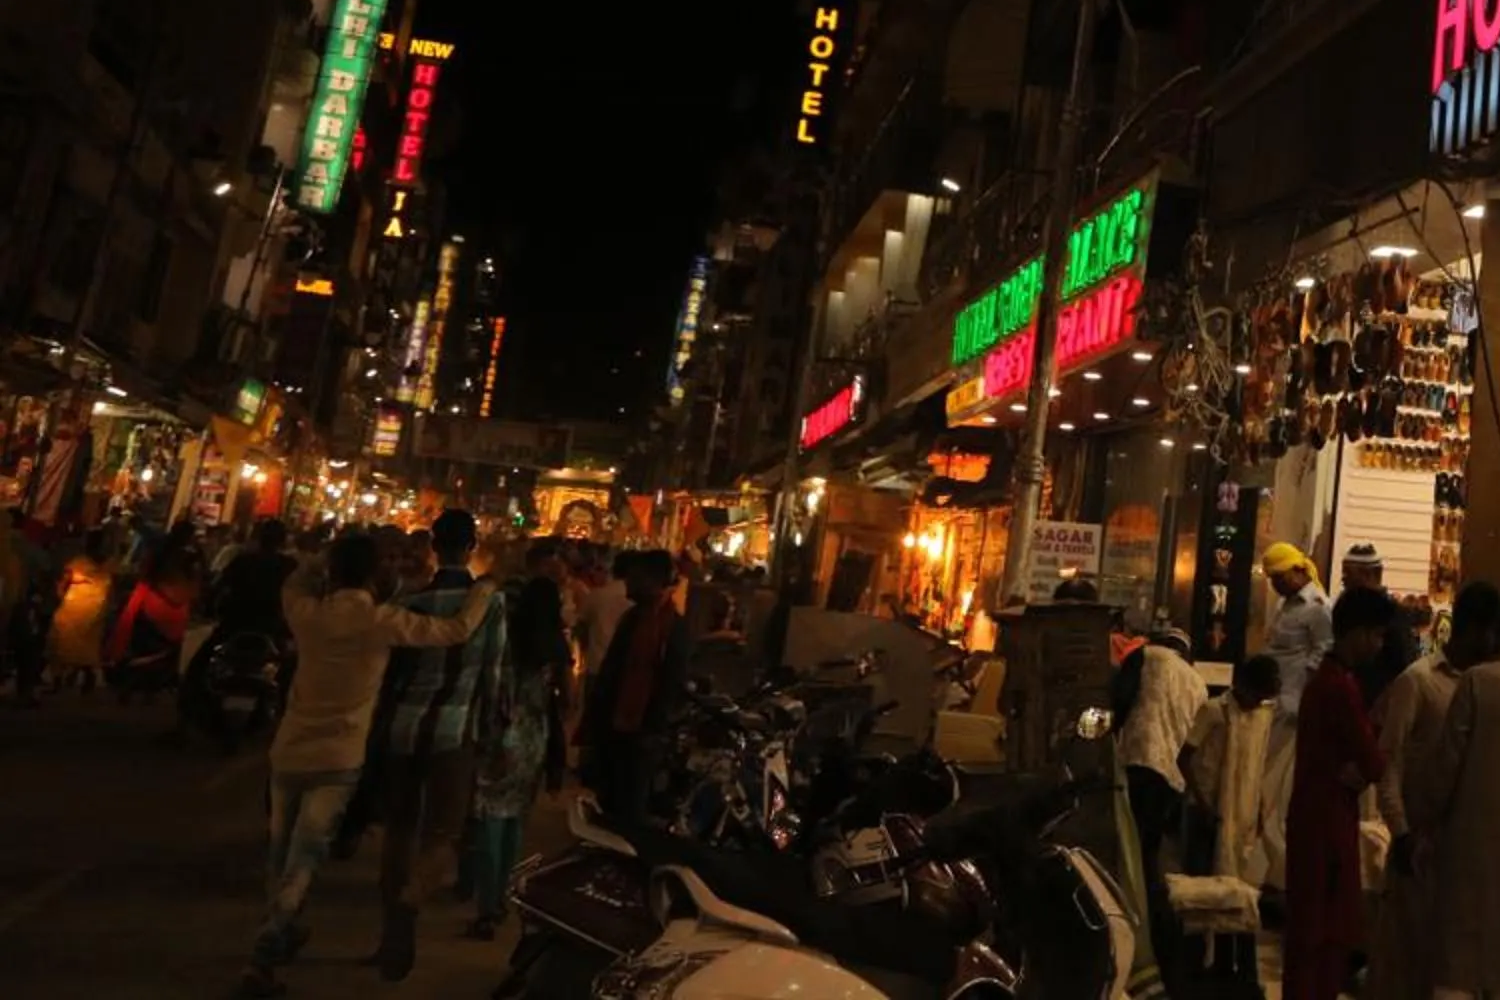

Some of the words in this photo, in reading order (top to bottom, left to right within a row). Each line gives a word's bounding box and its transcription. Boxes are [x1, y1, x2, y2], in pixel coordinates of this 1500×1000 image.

[409, 39, 454, 60] NEW
[797, 7, 839, 144] HOTEL
[299, 68, 355, 207] DARBAR
[395, 64, 437, 181] HOTEL
[1033, 527, 1095, 543] SAGAR
